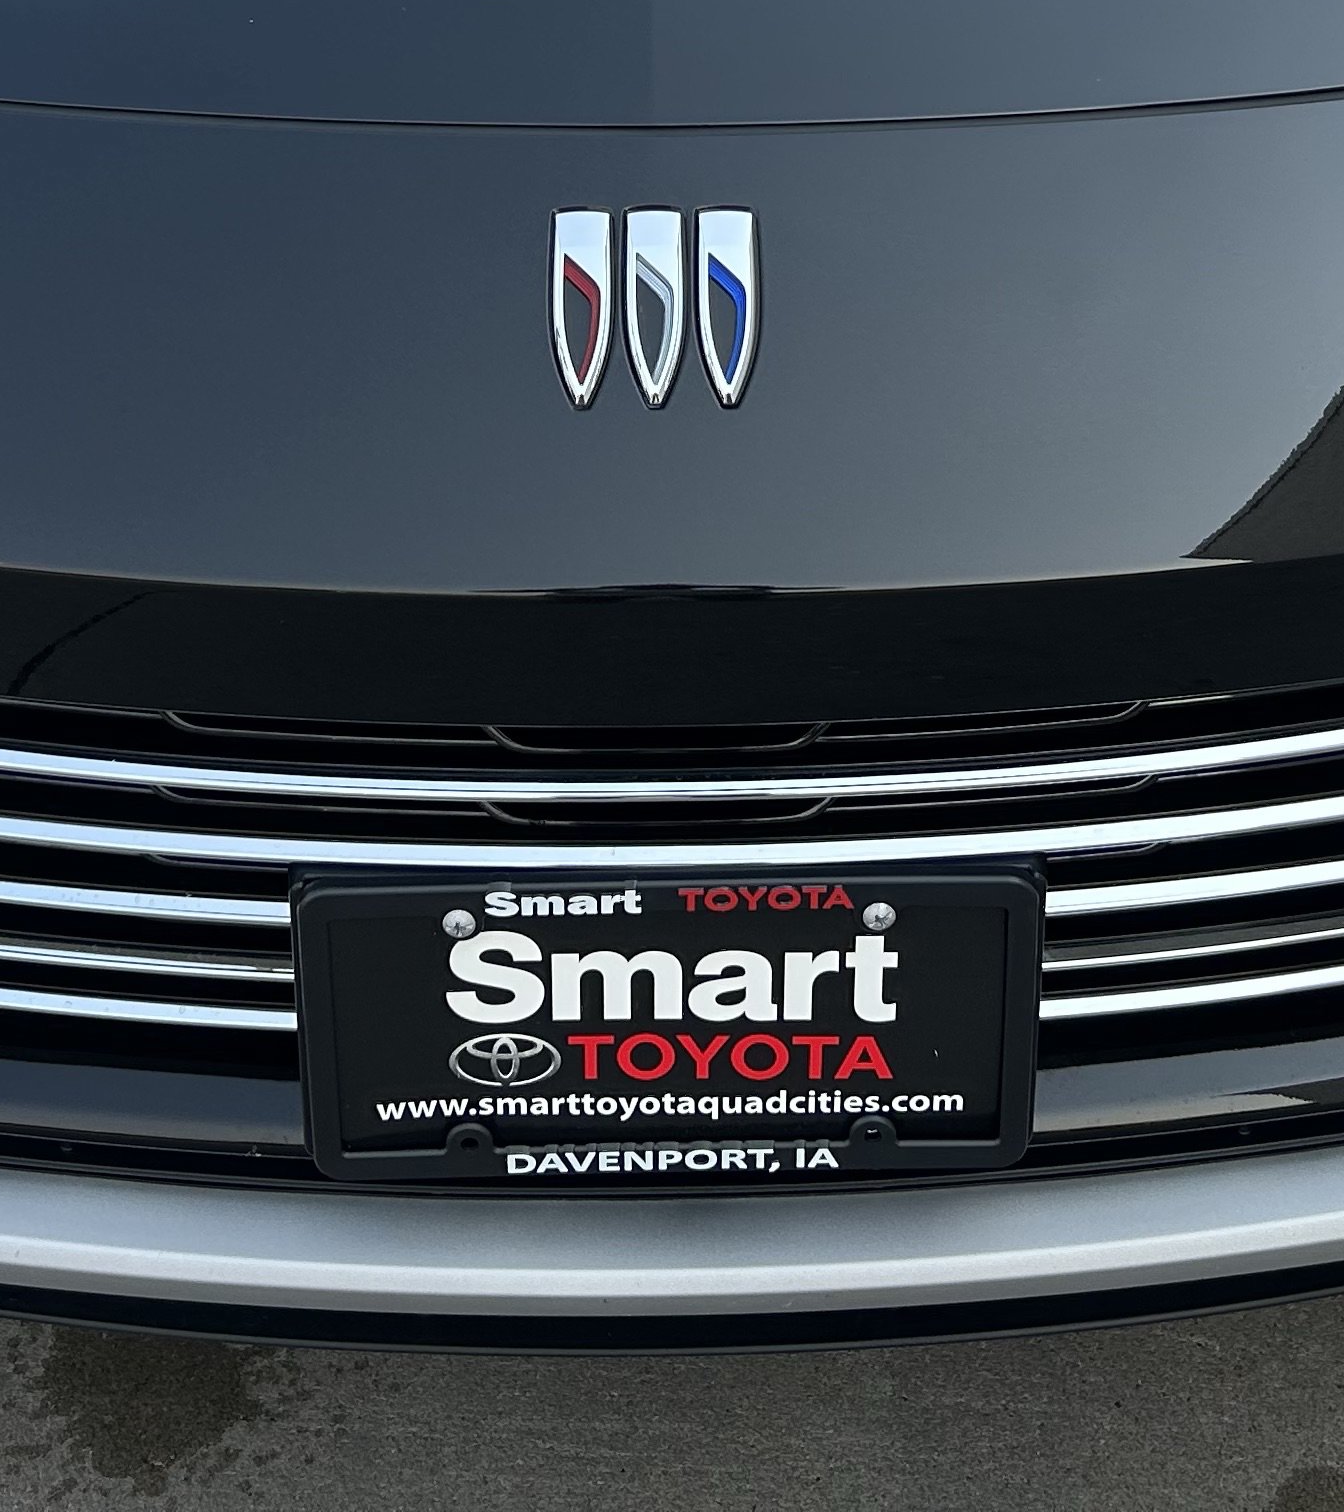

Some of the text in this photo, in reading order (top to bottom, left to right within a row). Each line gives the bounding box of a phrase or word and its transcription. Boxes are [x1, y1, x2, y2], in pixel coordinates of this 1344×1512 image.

[485, 886, 854, 917] Smart TOYOTA
[446, 930, 899, 1024] Smart
[566, 1032, 894, 1081] TOYOTA
[376, 1090, 965, 1122] www.smarttoyotaquadcities.com
[506, 1147, 840, 1174] DAVENPORT, IA
